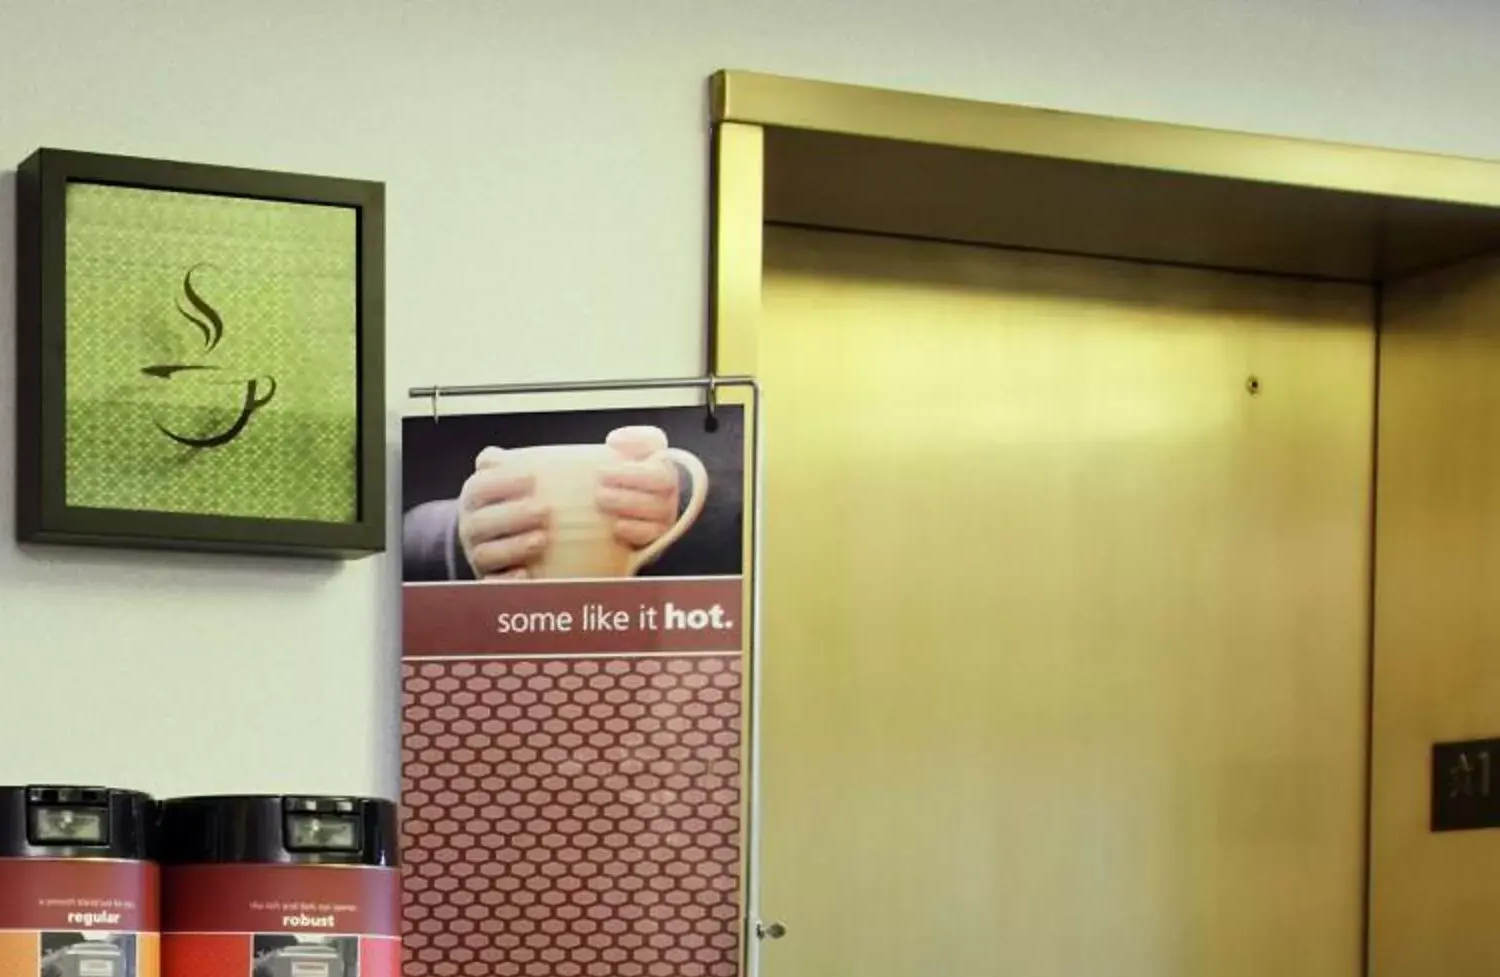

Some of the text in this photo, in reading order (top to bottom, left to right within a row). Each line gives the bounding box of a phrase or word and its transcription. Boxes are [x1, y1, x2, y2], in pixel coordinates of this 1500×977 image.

[497, 602, 734, 634] some like it hot.
[67, 909, 121, 927] regular
[283, 913, 336, 928] robust
